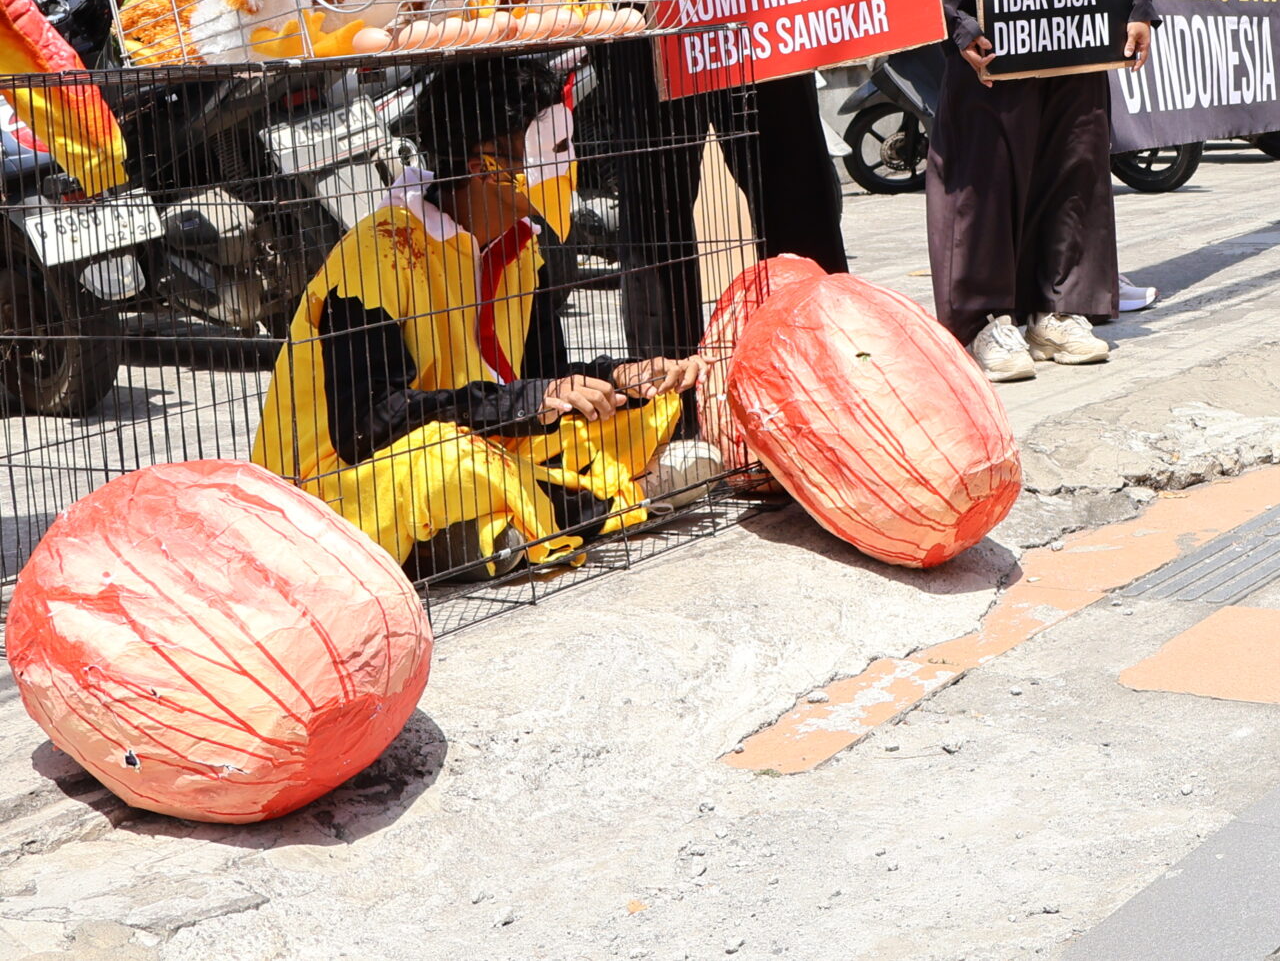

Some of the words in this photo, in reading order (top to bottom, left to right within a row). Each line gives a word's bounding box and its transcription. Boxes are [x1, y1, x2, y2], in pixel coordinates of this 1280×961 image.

[684, 21, 772, 74] BEBAS
[993, 12, 1110, 57] DIBIARKAN
[1150, 14, 1277, 112] INDONESIA
